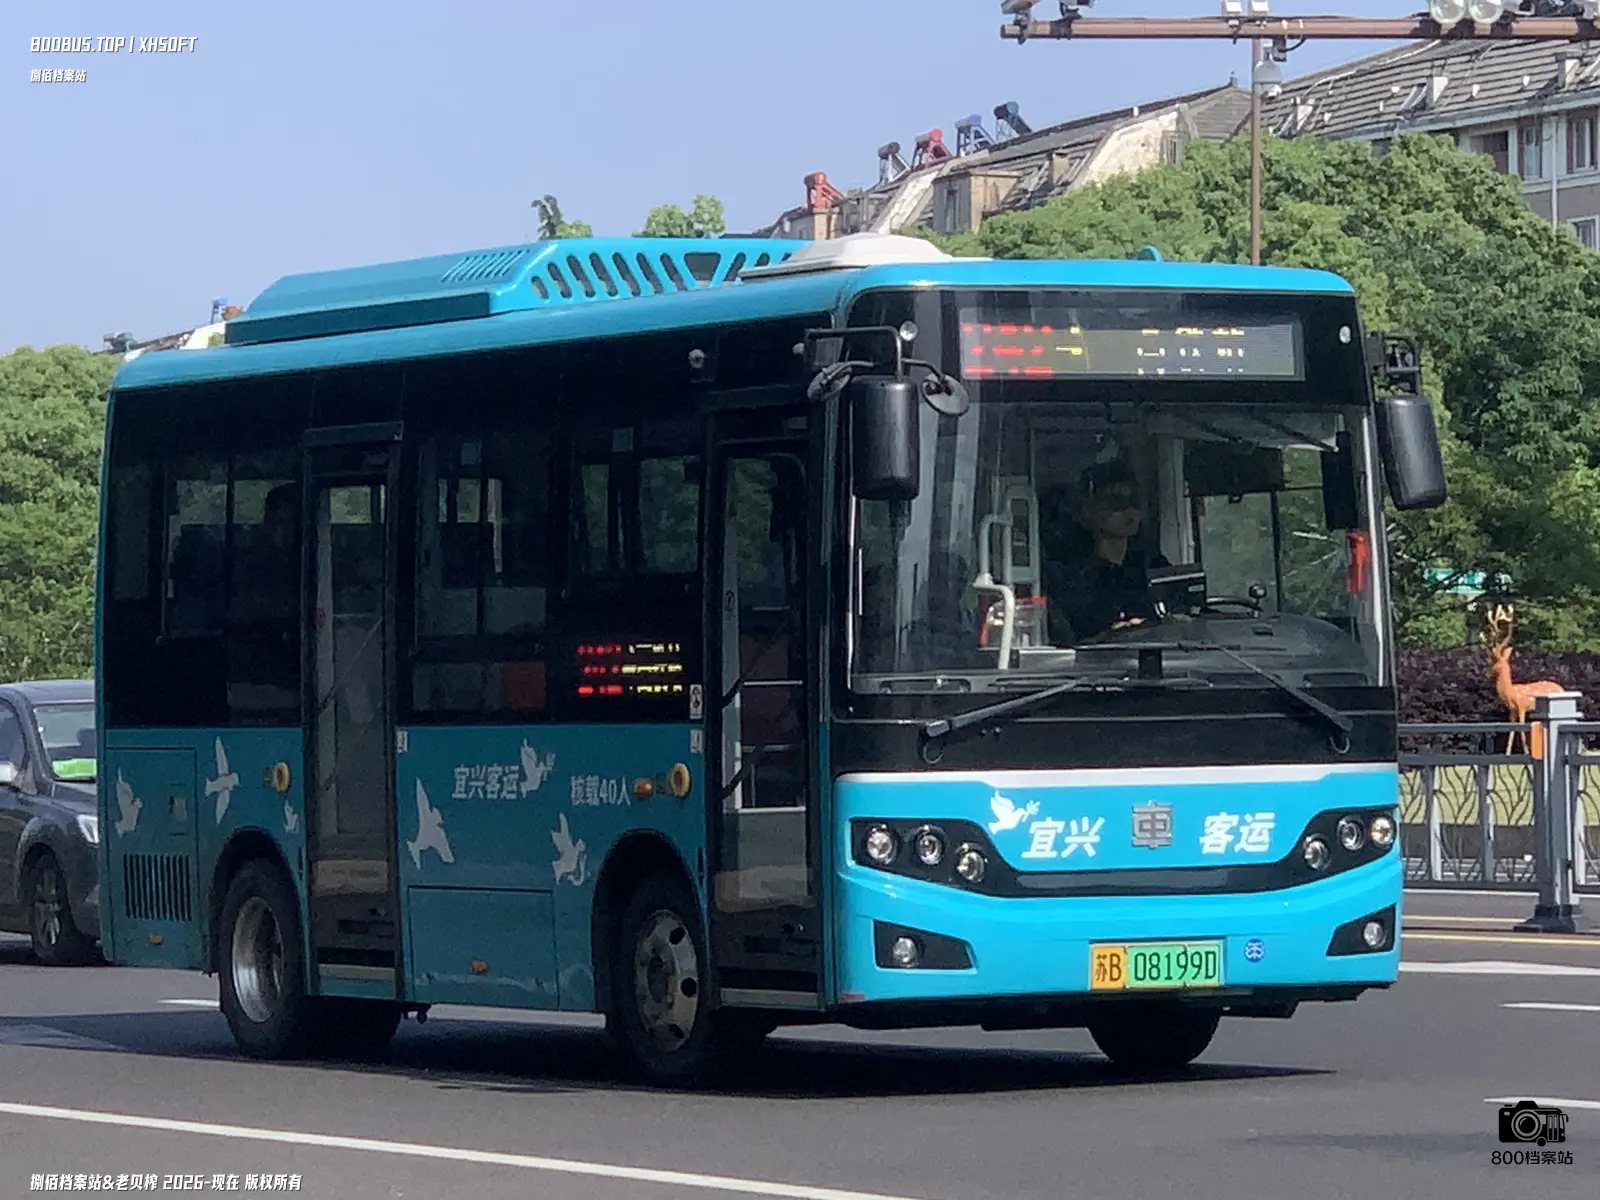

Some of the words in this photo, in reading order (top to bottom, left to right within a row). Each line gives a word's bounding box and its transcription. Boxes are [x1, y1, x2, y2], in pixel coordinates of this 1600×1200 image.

[452, 763, 520, 800] 宜兴客运
[1021, 815, 1105, 859] 宜兴
[1199, 811, 1275, 855] 客运
